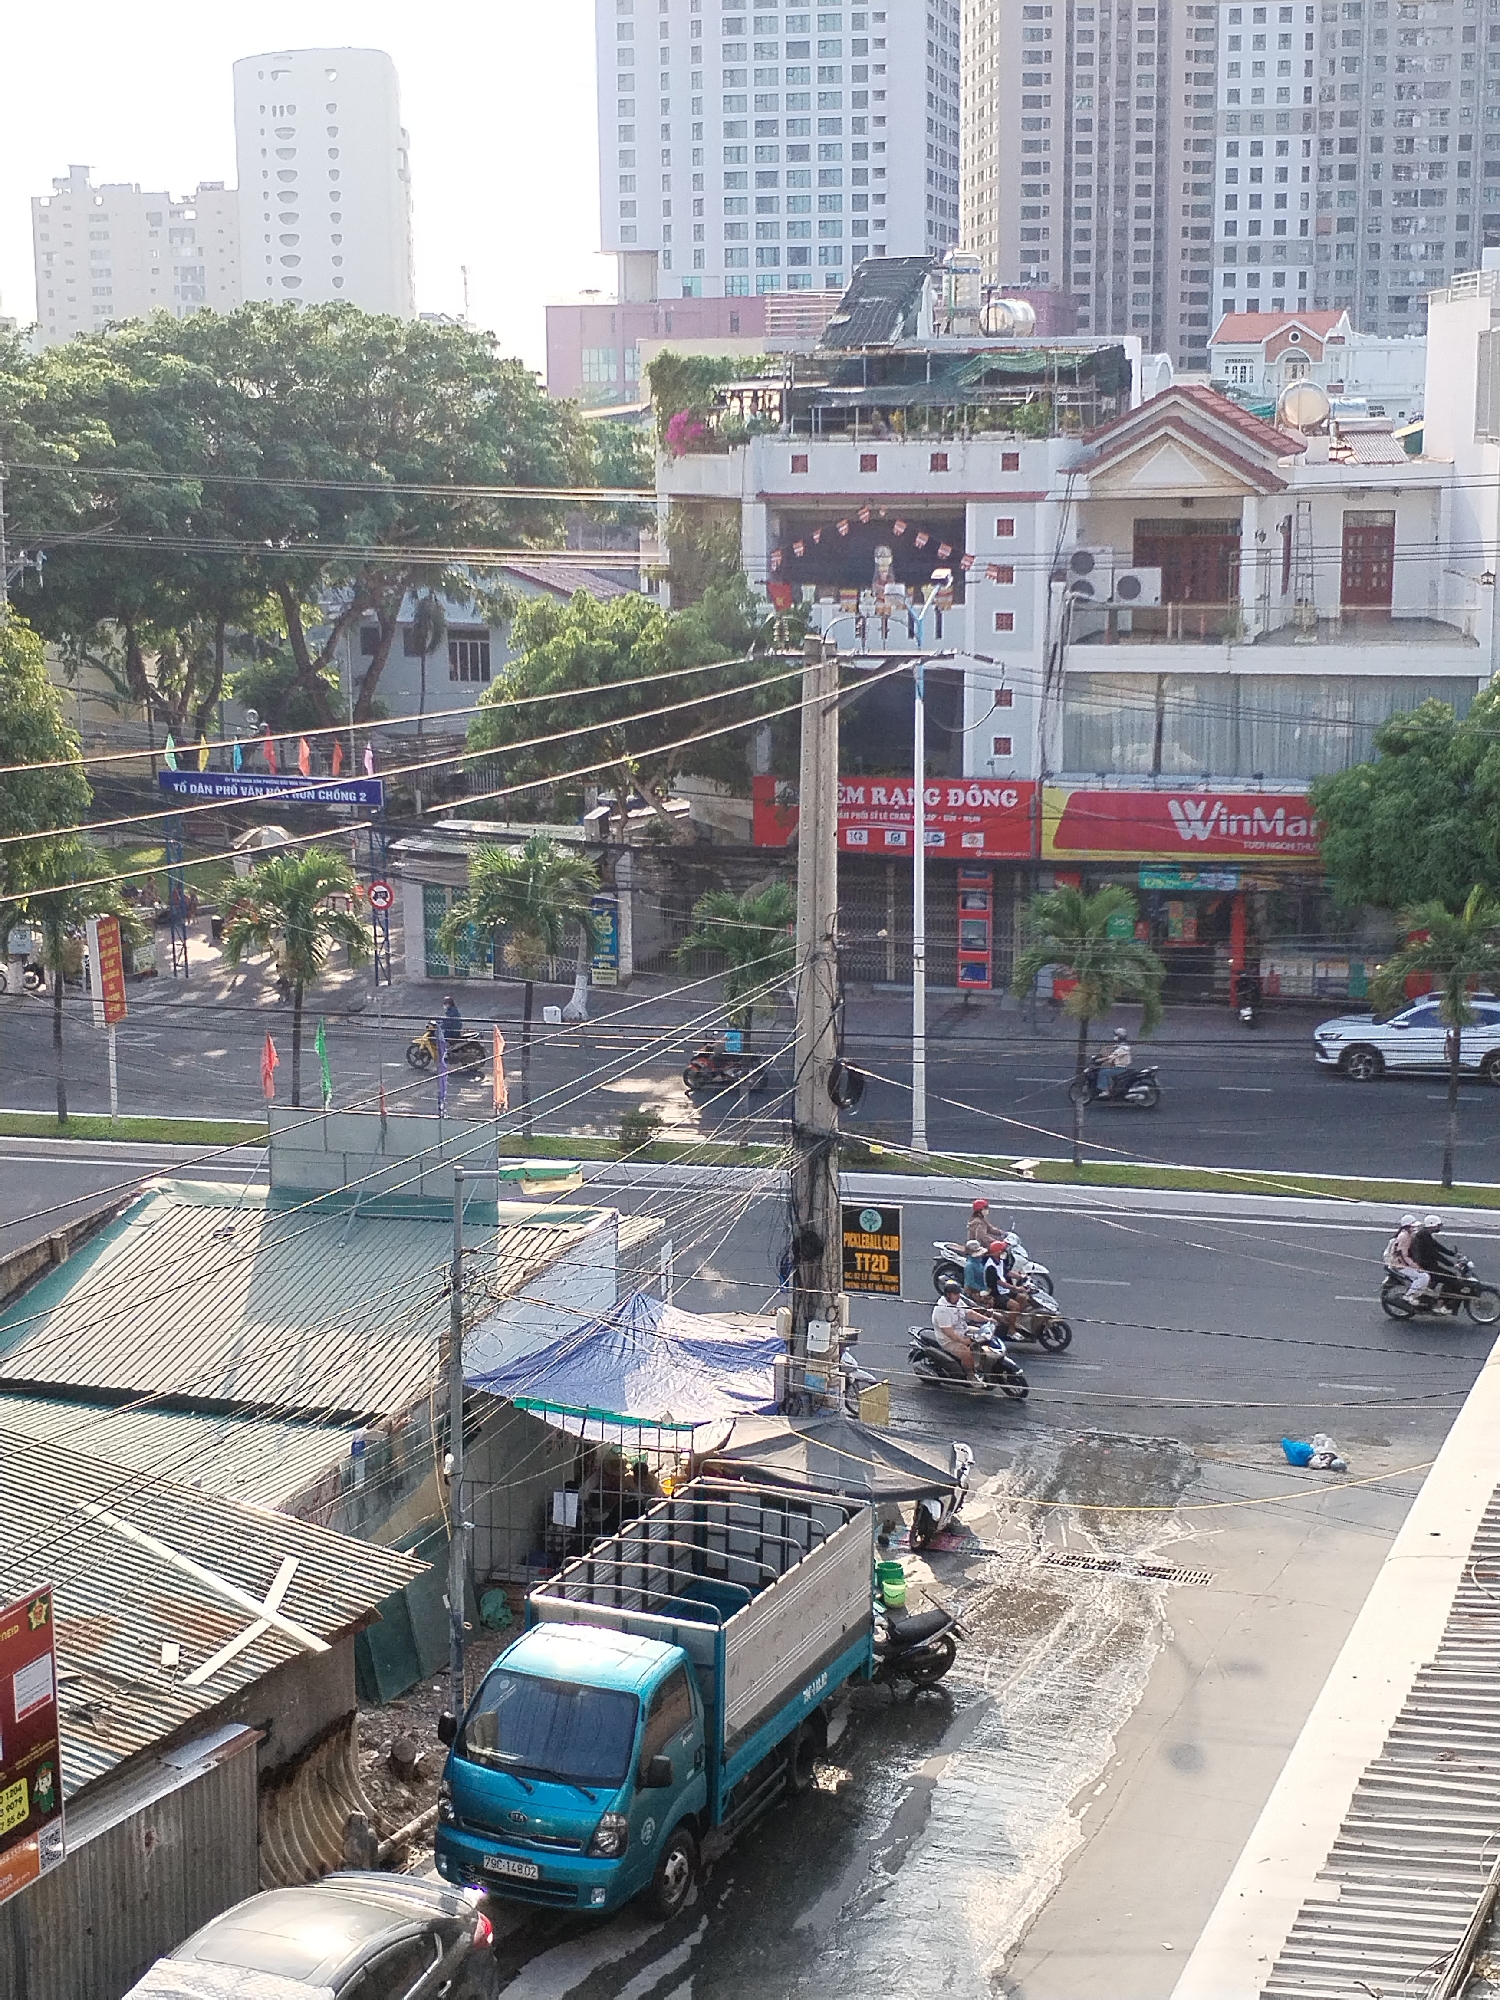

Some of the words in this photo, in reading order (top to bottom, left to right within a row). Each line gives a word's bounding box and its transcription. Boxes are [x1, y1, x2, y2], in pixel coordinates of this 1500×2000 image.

[189, 782, 213, 795] DÂN
[240, 785, 264, 796] VĂN
[359, 792, 367, 802] 2
[946, 783, 1019, 807] ĐÔNG
[843, 1232, 882, 1250] PICKLEBALL
[882, 1235, 900, 1251] CLUB
[855, 1252, 889, 1273] TT2D
